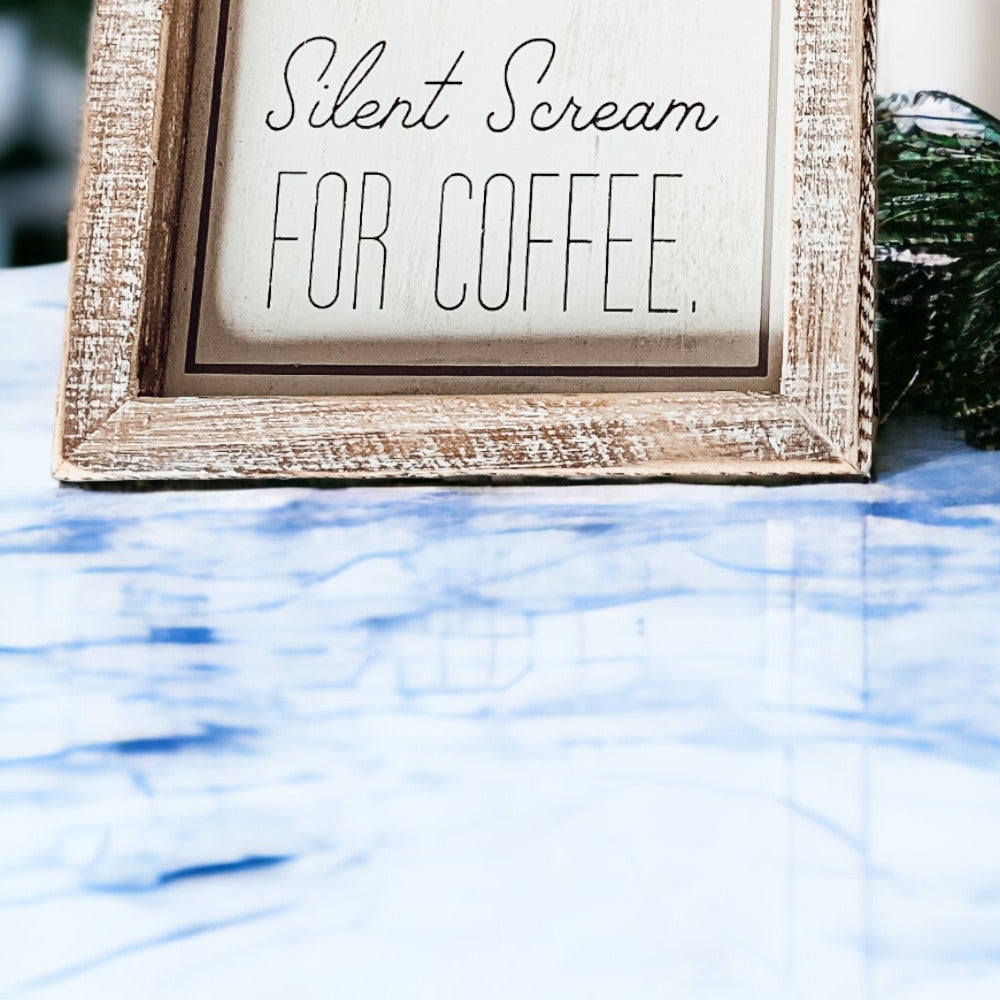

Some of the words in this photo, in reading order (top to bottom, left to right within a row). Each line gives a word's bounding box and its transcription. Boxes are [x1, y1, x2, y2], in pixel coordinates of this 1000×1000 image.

[265, 35, 465, 133] Silent
[486, 37, 719, 134] Scream
[266, 171, 392, 310] FOR
[434, 172, 697, 314] COFFEE.
